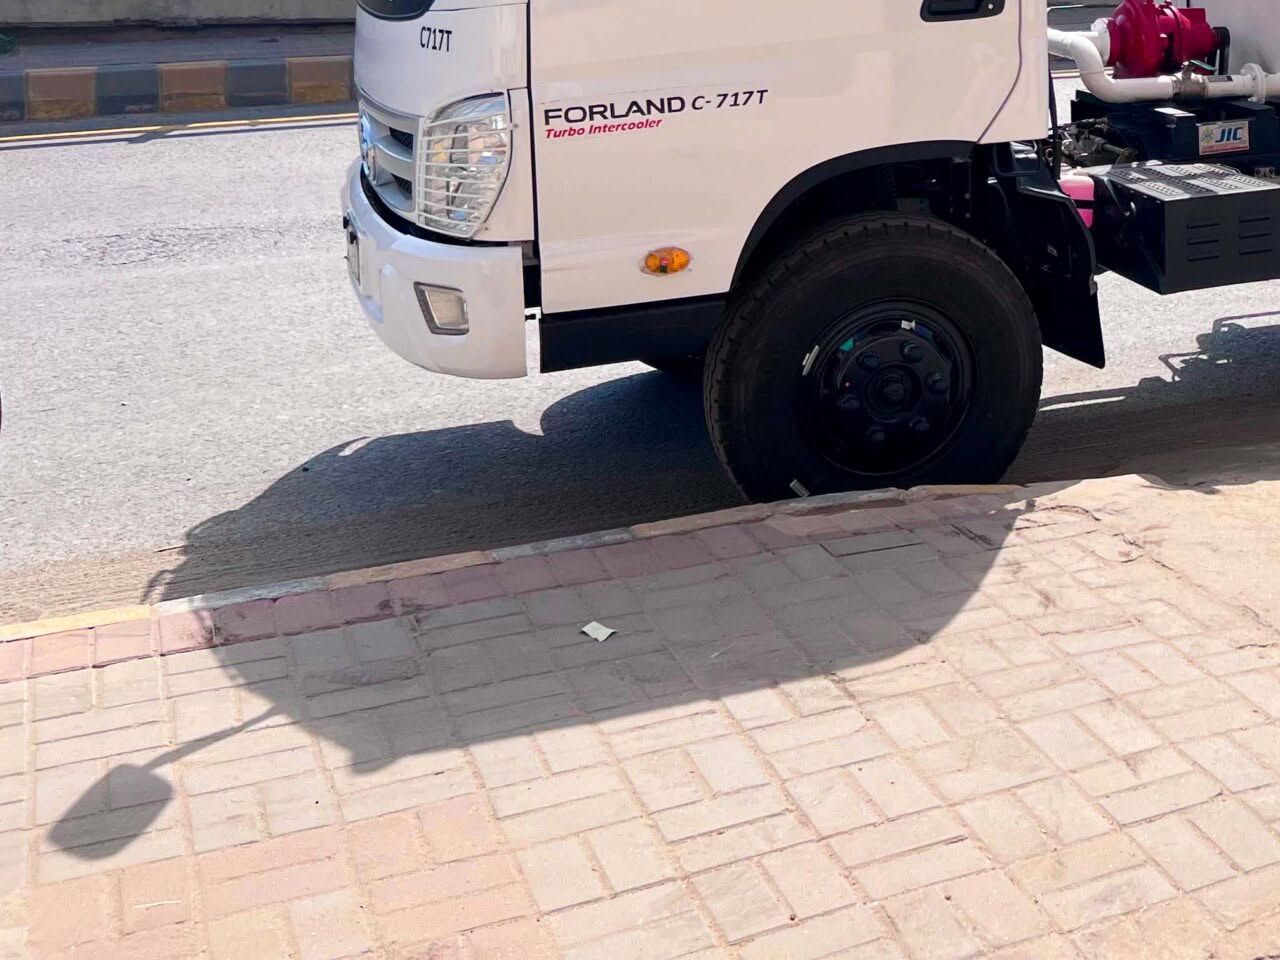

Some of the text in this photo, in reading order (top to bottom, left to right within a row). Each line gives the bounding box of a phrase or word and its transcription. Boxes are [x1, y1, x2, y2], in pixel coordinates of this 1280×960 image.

[420, 26, 453, 53] C717T
[543, 96, 686, 125] FORLAND
[545, 118, 663, 139] Turbo Intercooler
[1215, 126, 1244, 143] JIC
